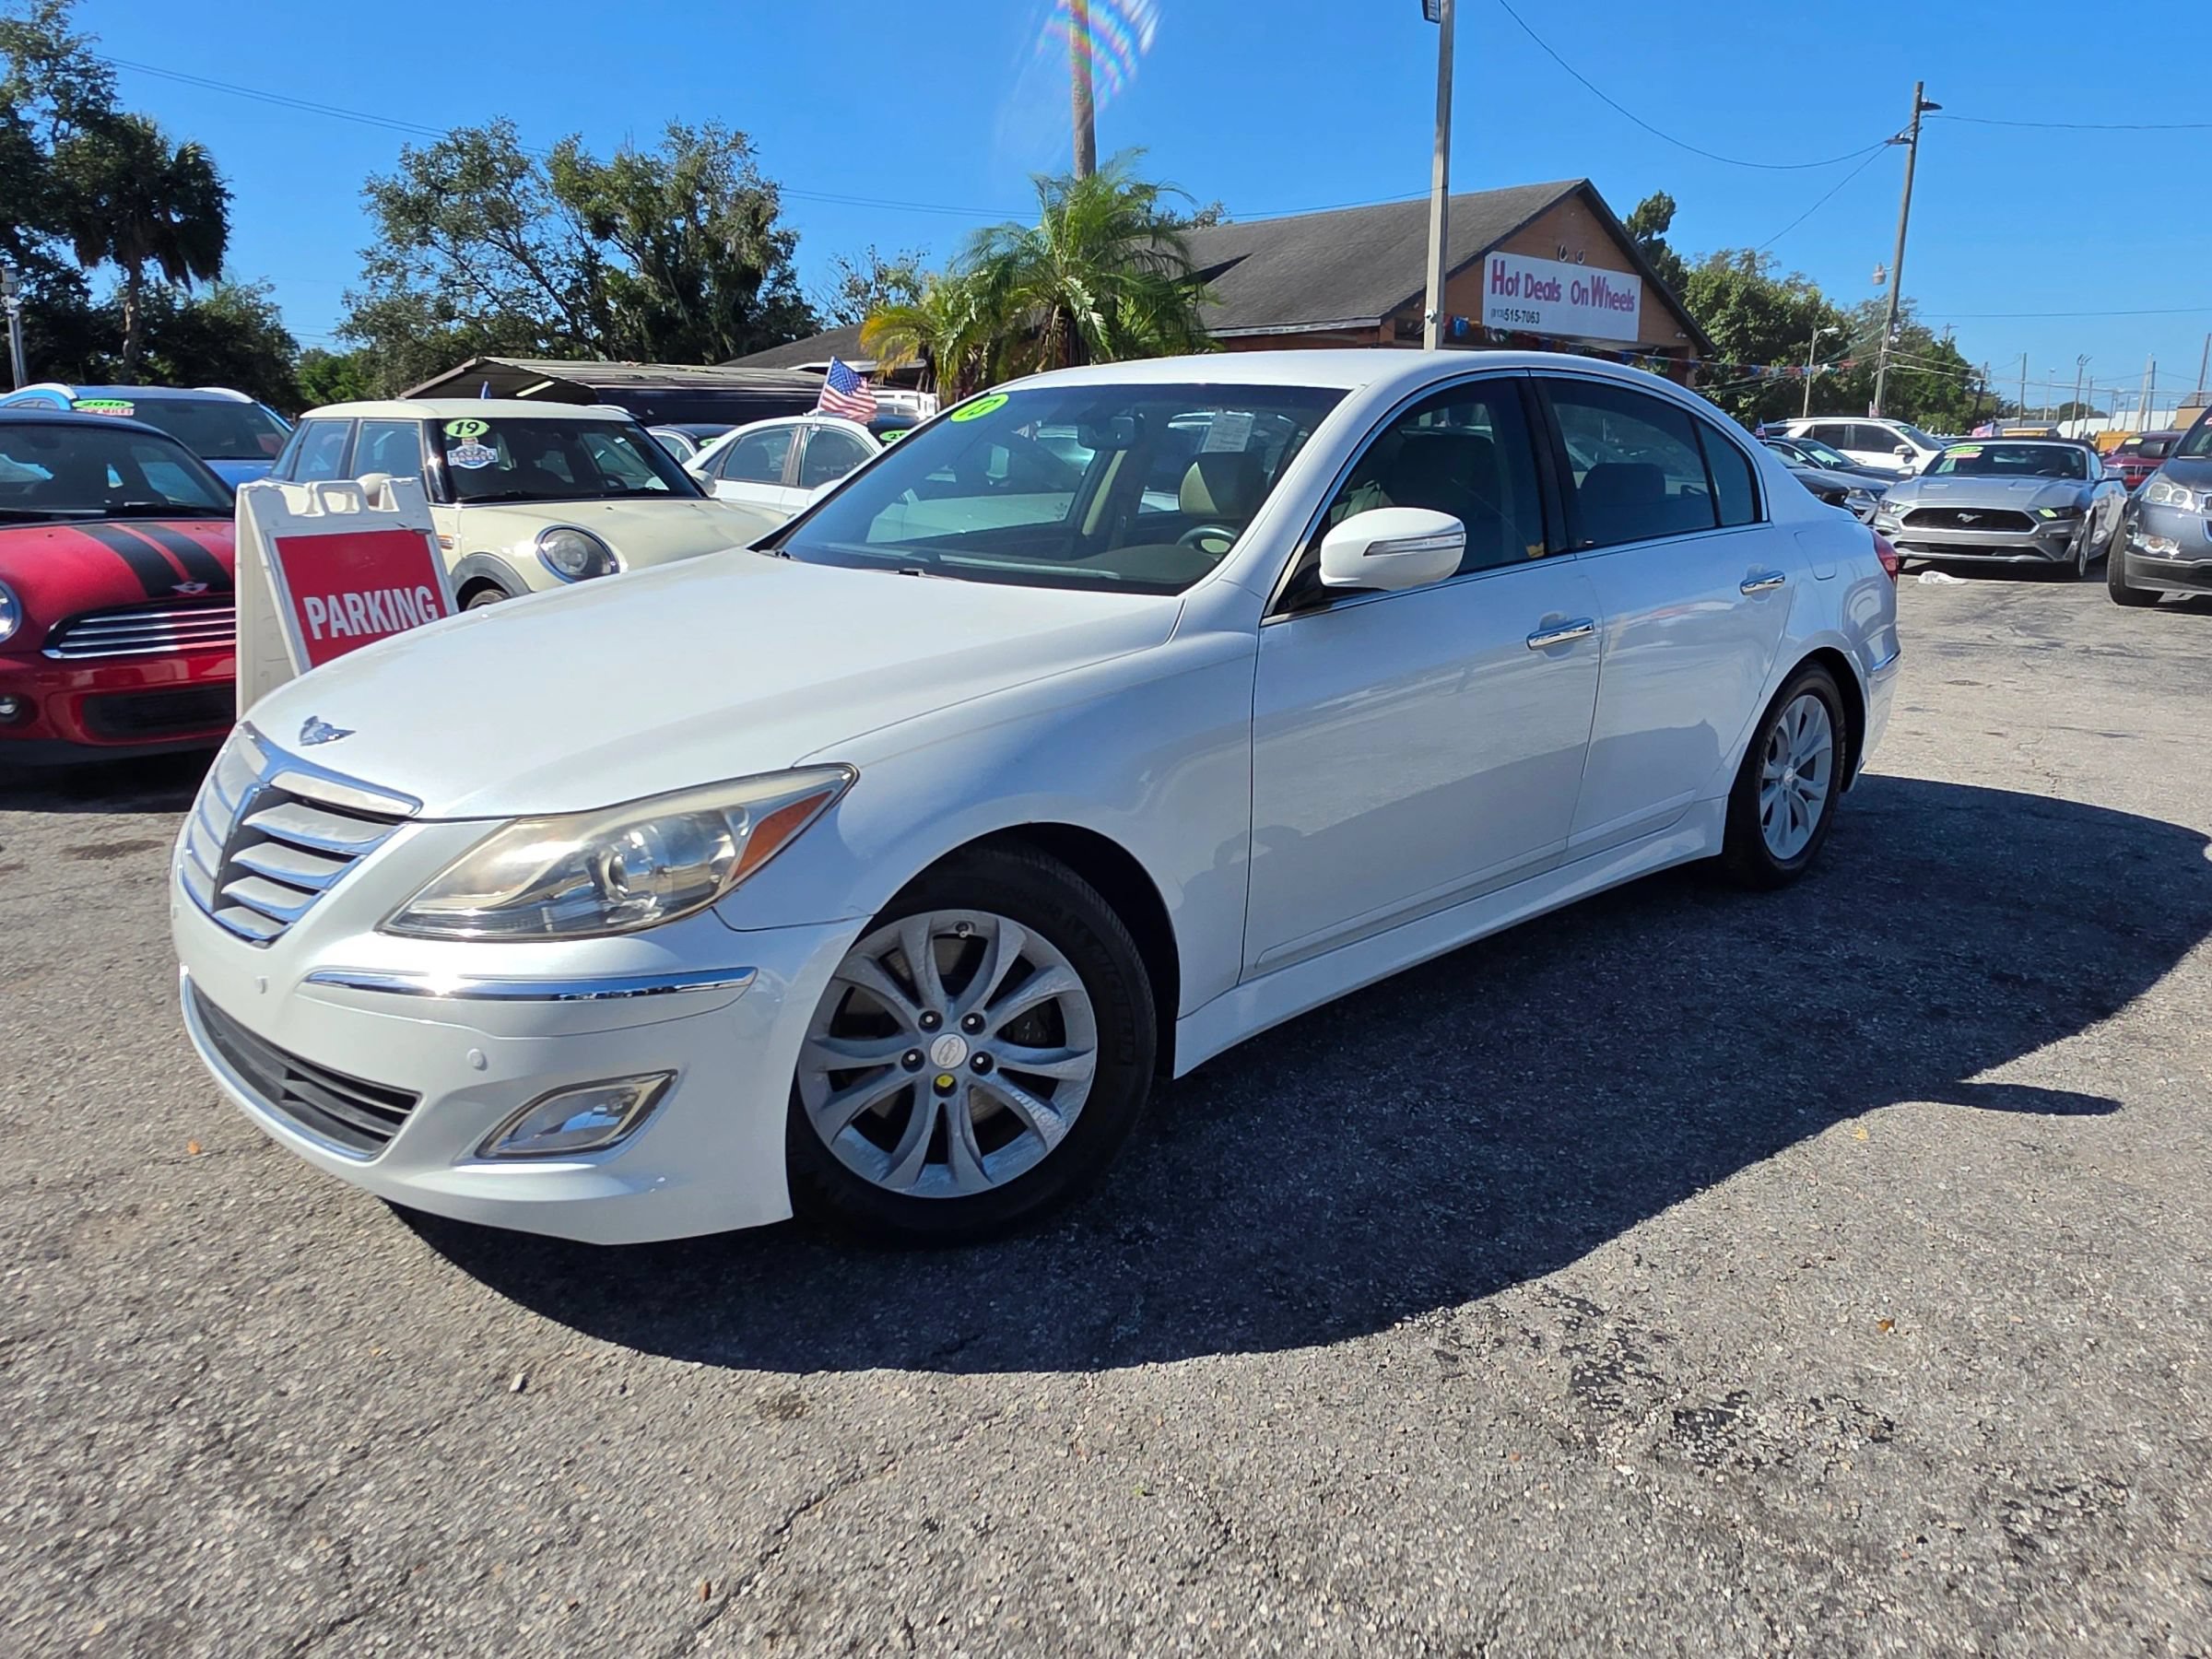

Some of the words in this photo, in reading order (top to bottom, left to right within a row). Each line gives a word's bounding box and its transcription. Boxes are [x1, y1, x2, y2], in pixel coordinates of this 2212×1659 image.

[1491, 259, 1520, 297] Hot
[1524, 273, 1561, 302] Deals
[1571, 279, 1589, 306] On
[1591, 275, 1635, 312] Wheels
[455, 421, 479, 434] 19
[302, 585, 439, 640] PARKING
